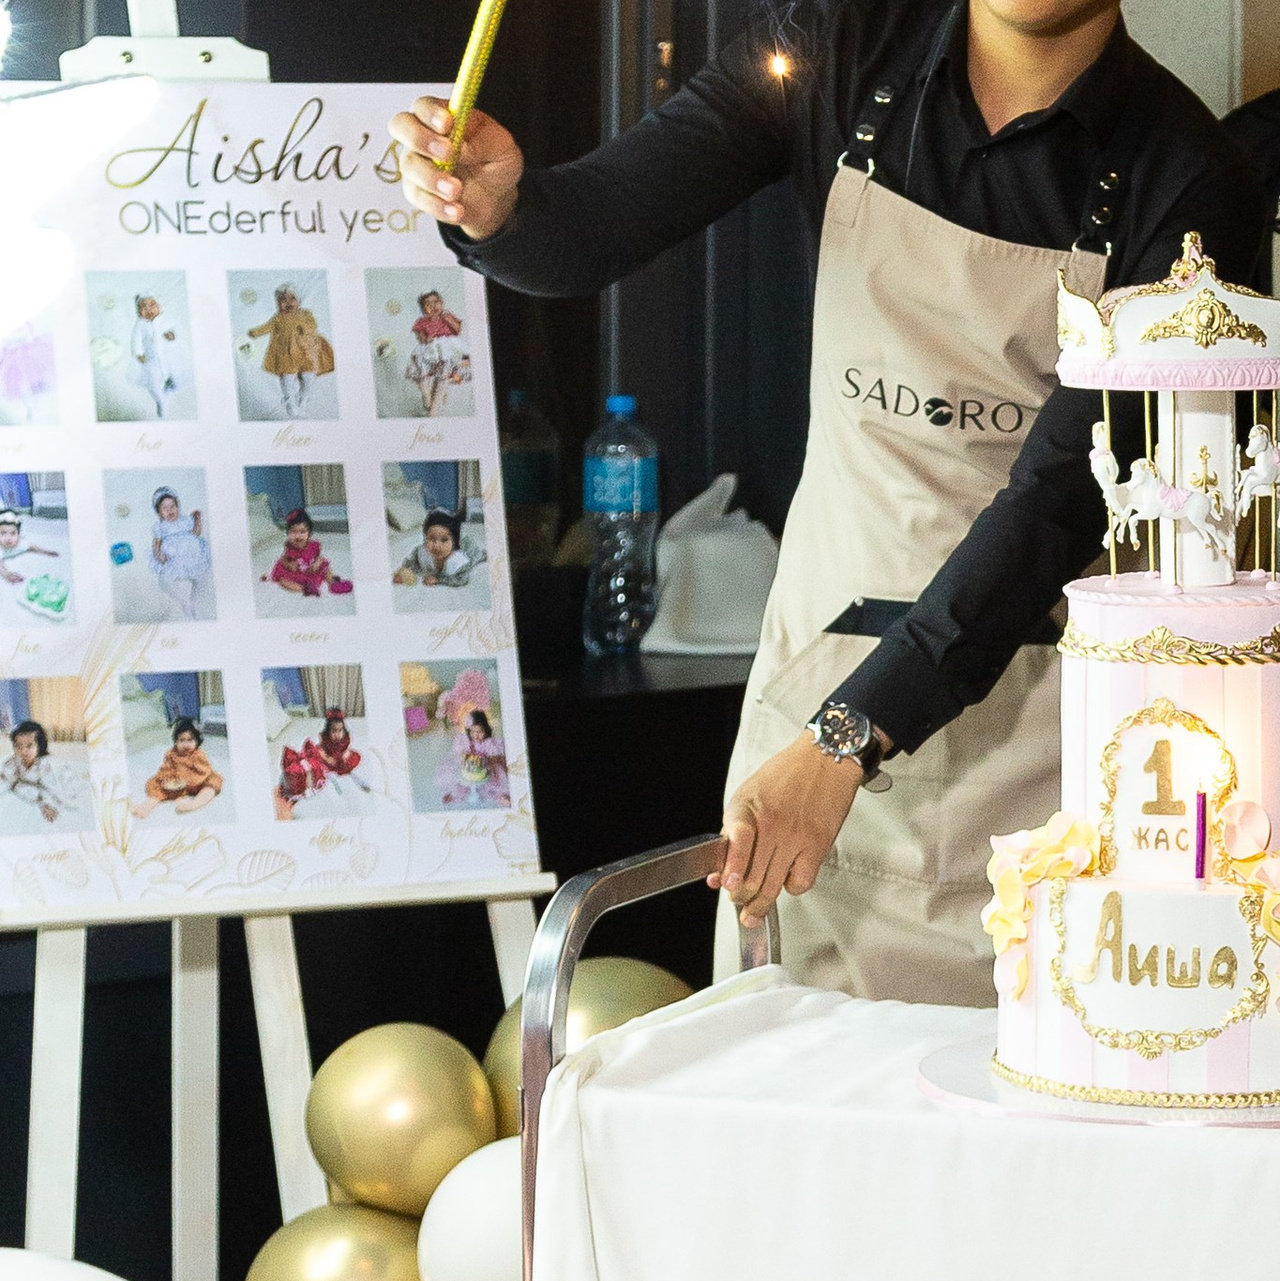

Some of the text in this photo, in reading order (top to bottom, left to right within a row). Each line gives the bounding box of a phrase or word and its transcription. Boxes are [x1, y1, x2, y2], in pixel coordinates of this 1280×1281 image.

[106, 97, 402, 188] Aisha's
[119, 200, 424, 242] ONEderful year
[841, 367, 1024, 433] SADORO
[1141, 739, 1186, 816] 1
[1130, 826, 1190, 852] ЖАС
[1072, 890, 1239, 989] Аиша
